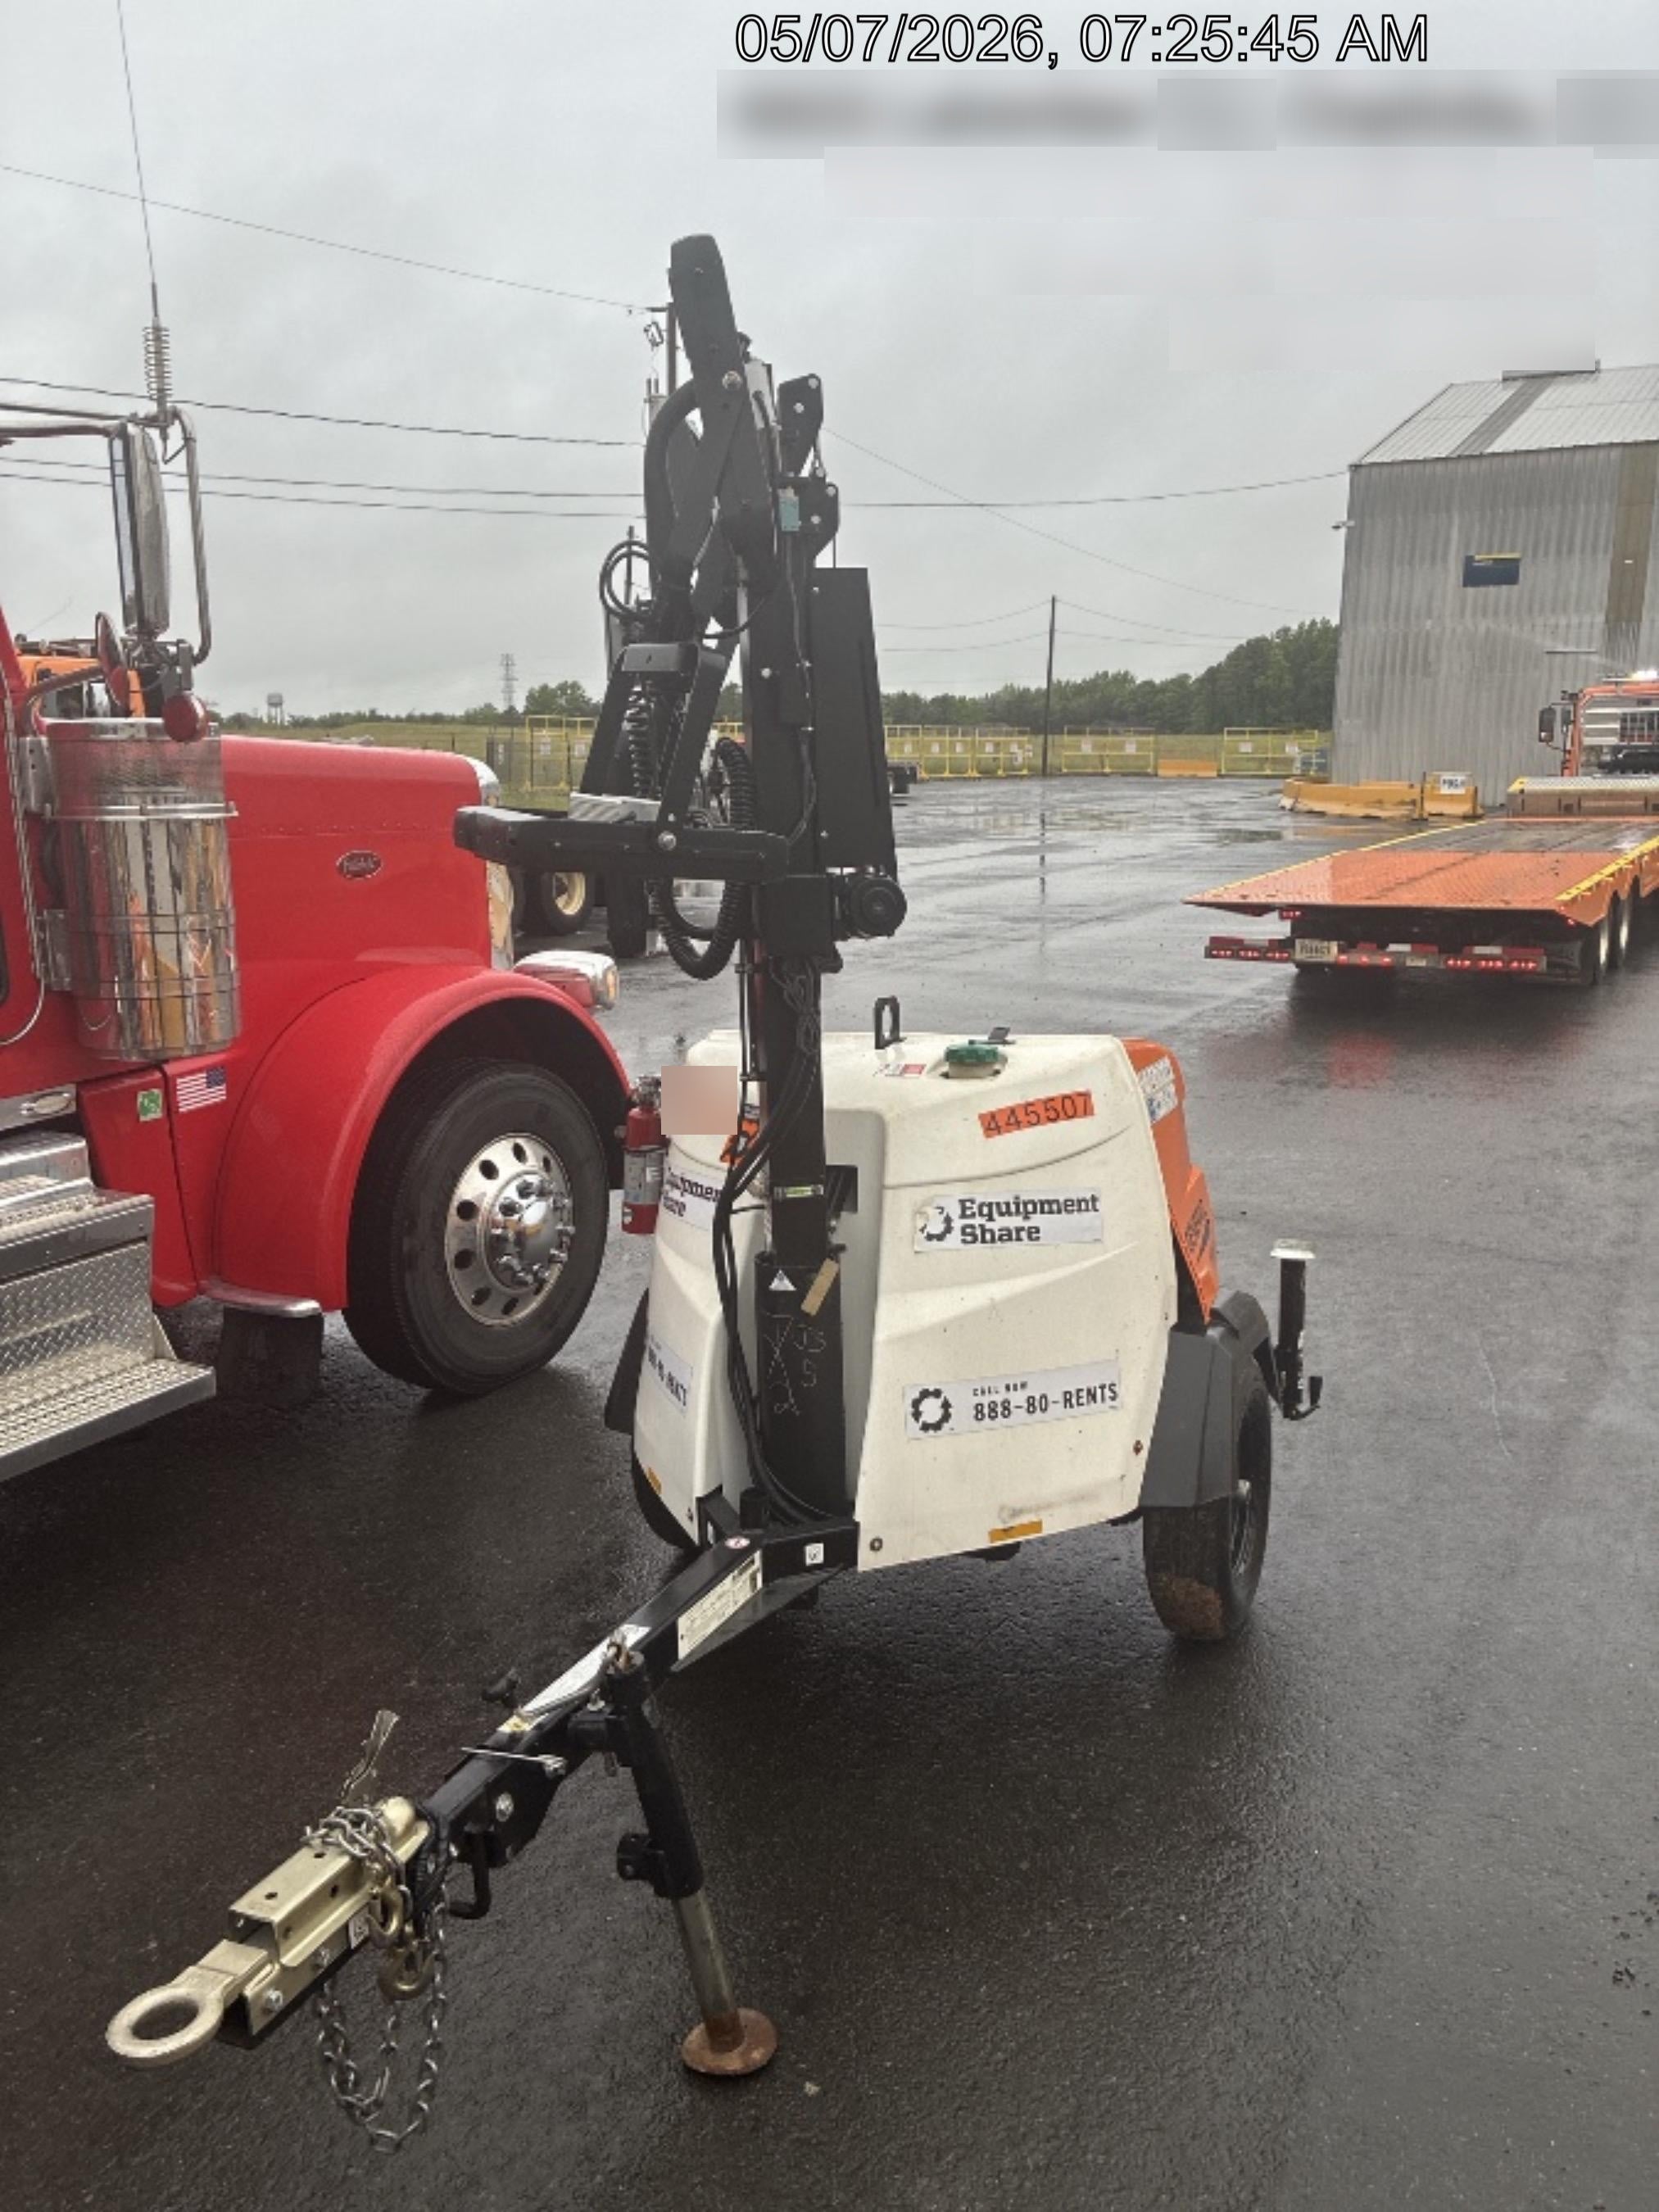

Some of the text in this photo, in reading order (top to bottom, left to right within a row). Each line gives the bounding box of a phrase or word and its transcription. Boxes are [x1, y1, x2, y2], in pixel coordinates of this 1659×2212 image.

[985, 1090, 1092, 1135] 445507
[958, 1194, 1099, 1222] Equipment
[960, 1223, 1041, 1245] Share
[973, 1382, 1119, 1422] 888-80-RENTS
